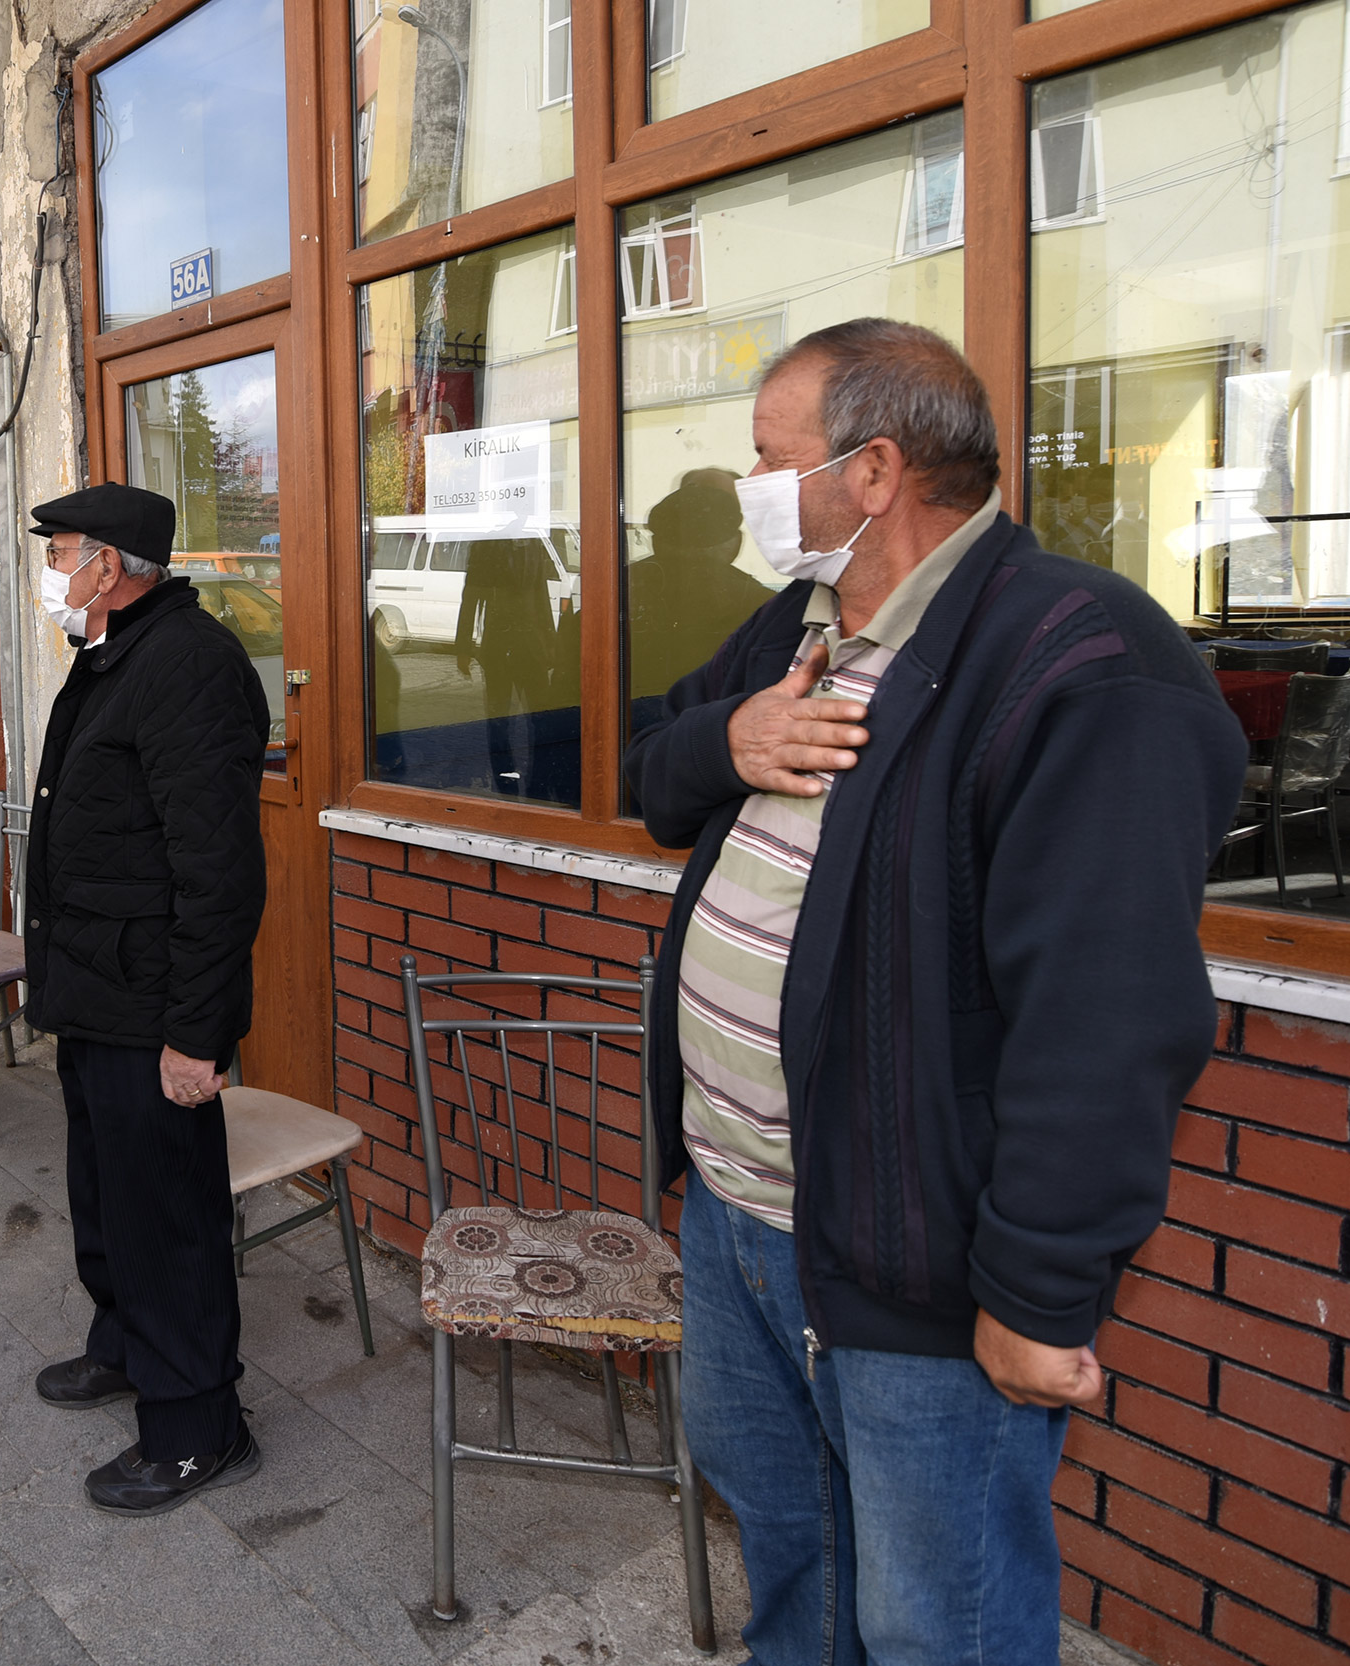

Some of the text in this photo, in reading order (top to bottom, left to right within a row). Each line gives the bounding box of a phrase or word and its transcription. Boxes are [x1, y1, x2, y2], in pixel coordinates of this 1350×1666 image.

[173, 258, 210, 298] 56A
[464, 435, 521, 458] KİRALIK
[433, 486, 526, 506] TEL:0532 350 50 49
